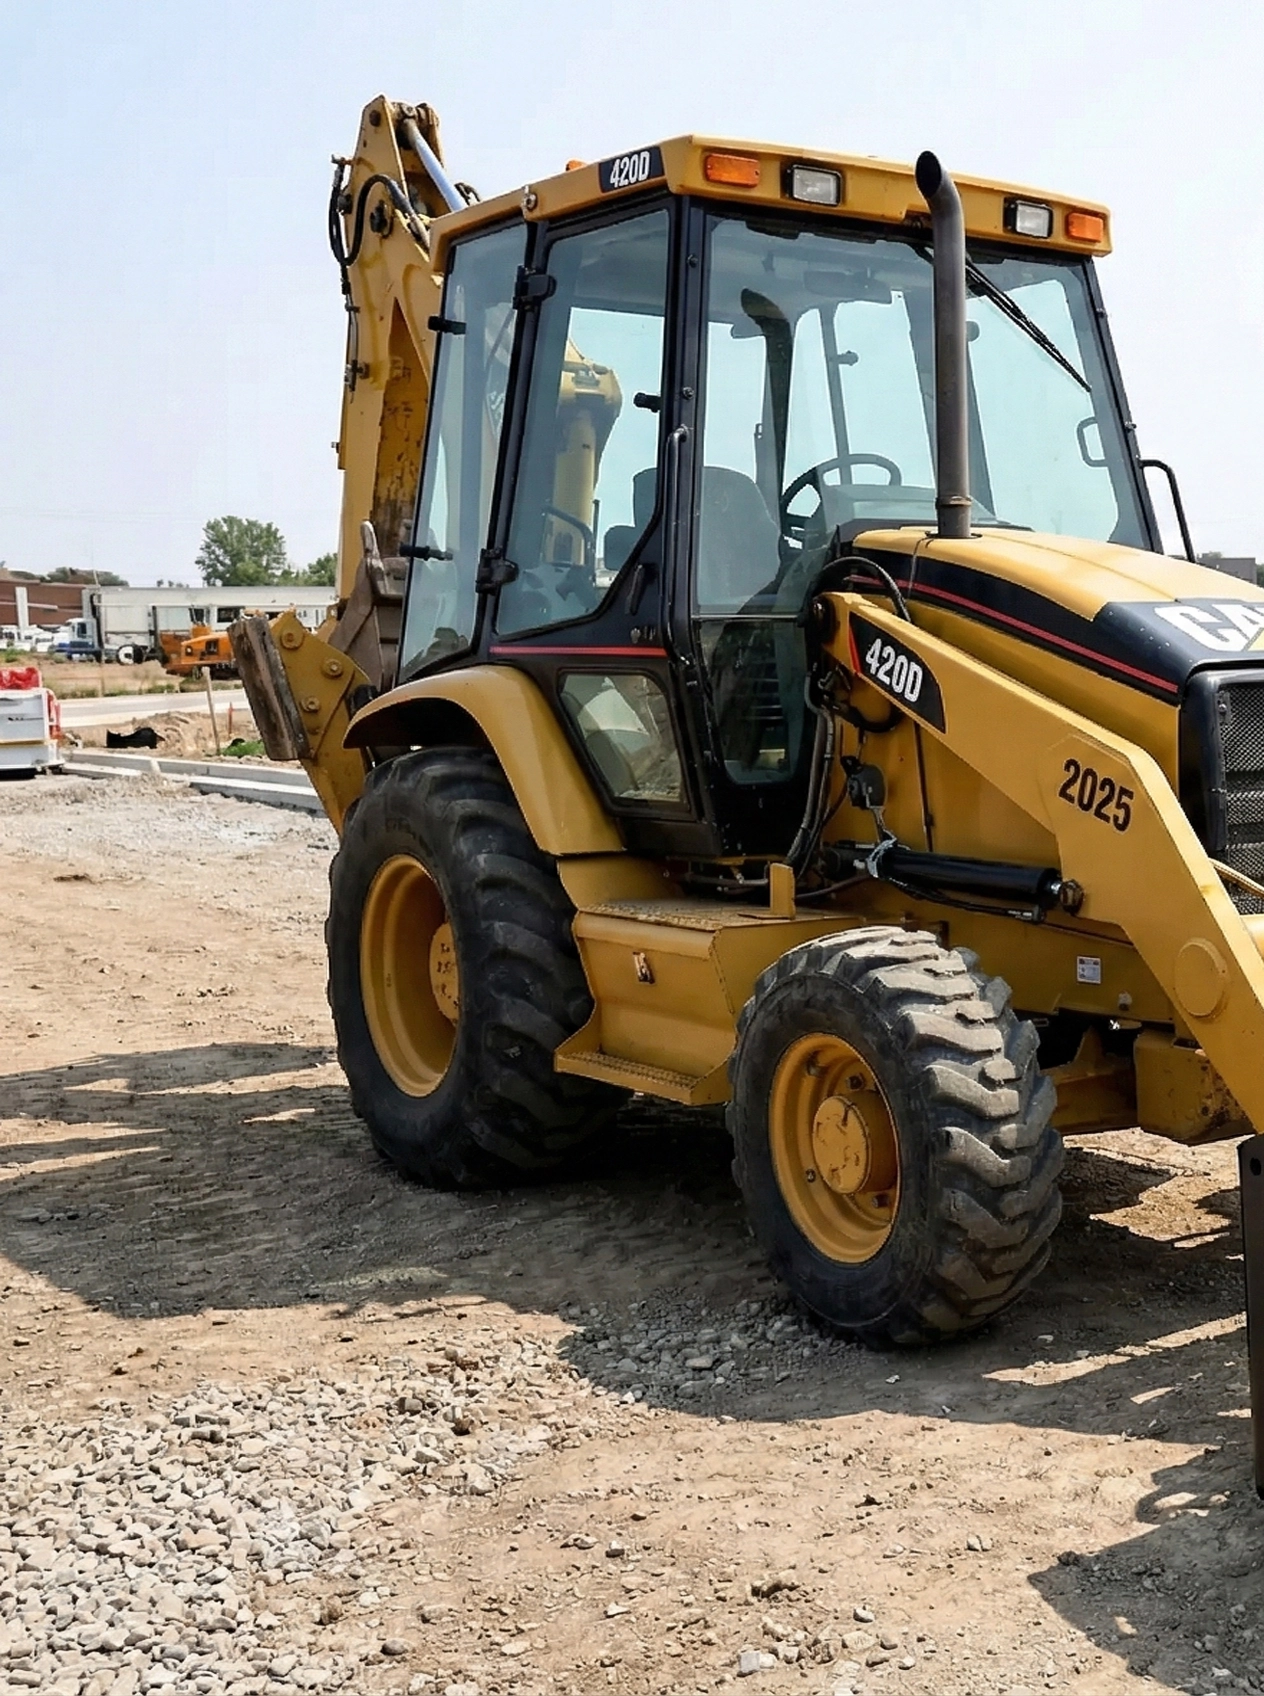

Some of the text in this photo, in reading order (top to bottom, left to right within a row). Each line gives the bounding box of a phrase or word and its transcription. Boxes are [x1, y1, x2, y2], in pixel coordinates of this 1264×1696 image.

[609, 150, 651, 188] 420D
[865, 638, 923, 703] 420D
[1058, 758, 1134, 832] 2025
